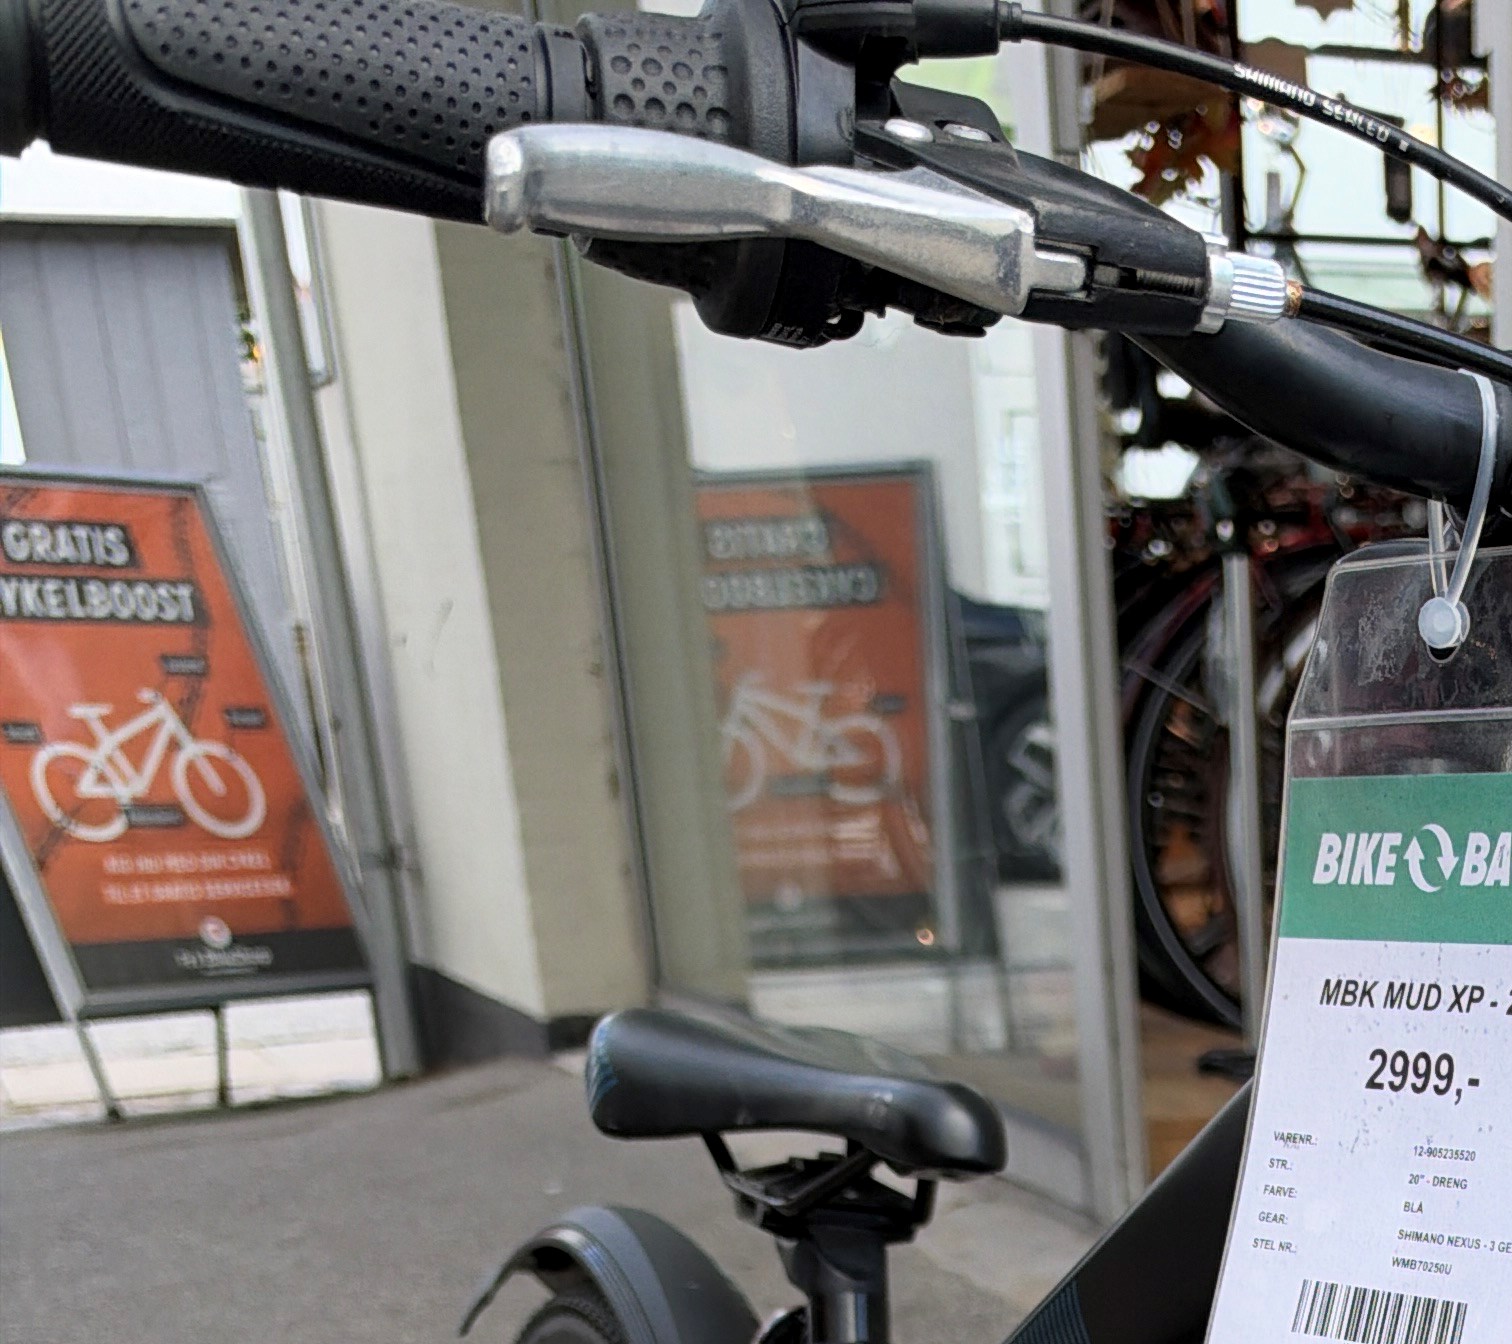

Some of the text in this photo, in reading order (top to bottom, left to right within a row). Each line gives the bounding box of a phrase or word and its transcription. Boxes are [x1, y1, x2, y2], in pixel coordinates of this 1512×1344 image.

[1321, 99, 1391, 143] SEALED
[2, 520, 130, 566] GRATIS
[1312, 832, 1403, 886] BIKE
[1319, 978, 1379, 1008] MBK
[1383, 981, 1442, 1012] MUD
[1446, 984, 1485, 1014] XP
[1364, 1048, 1480, 1105] 2999,-
[1263, 1184, 1298, 1199] FARVE:
[1432, 1175, 1468, 1190] DRENG
[1258, 1211, 1288, 1225] GEAR:
[1252, 1237, 1276, 1251] STEL
[1397, 1229, 1445, 1246] SHIMANO
[1446, 1235, 1481, 1250] NEXUS
[1489, 1240, 1496, 1252] 3
